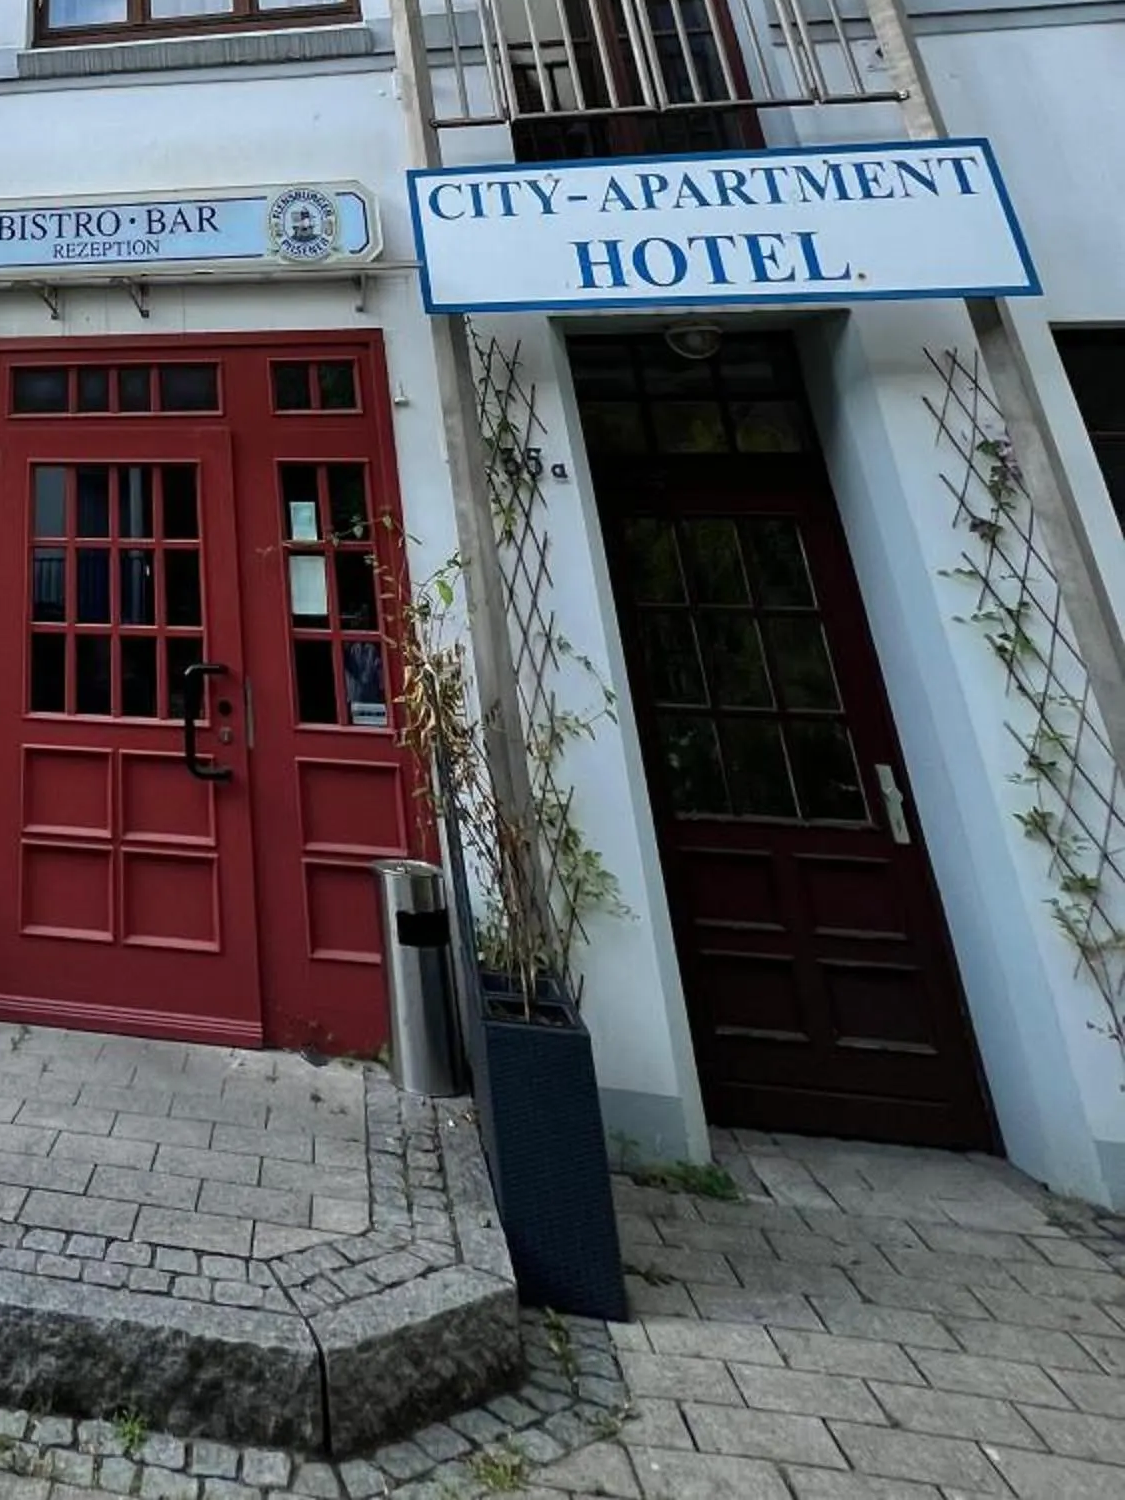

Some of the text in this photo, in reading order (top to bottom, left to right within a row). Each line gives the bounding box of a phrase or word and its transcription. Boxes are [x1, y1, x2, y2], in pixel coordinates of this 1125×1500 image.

[428, 156, 980, 220] CITY-APARTMENT
[146, 205, 220, 236] BAR
[53, 239, 160, 260] REZEPTION
[568, 231, 852, 289] HOTEL
